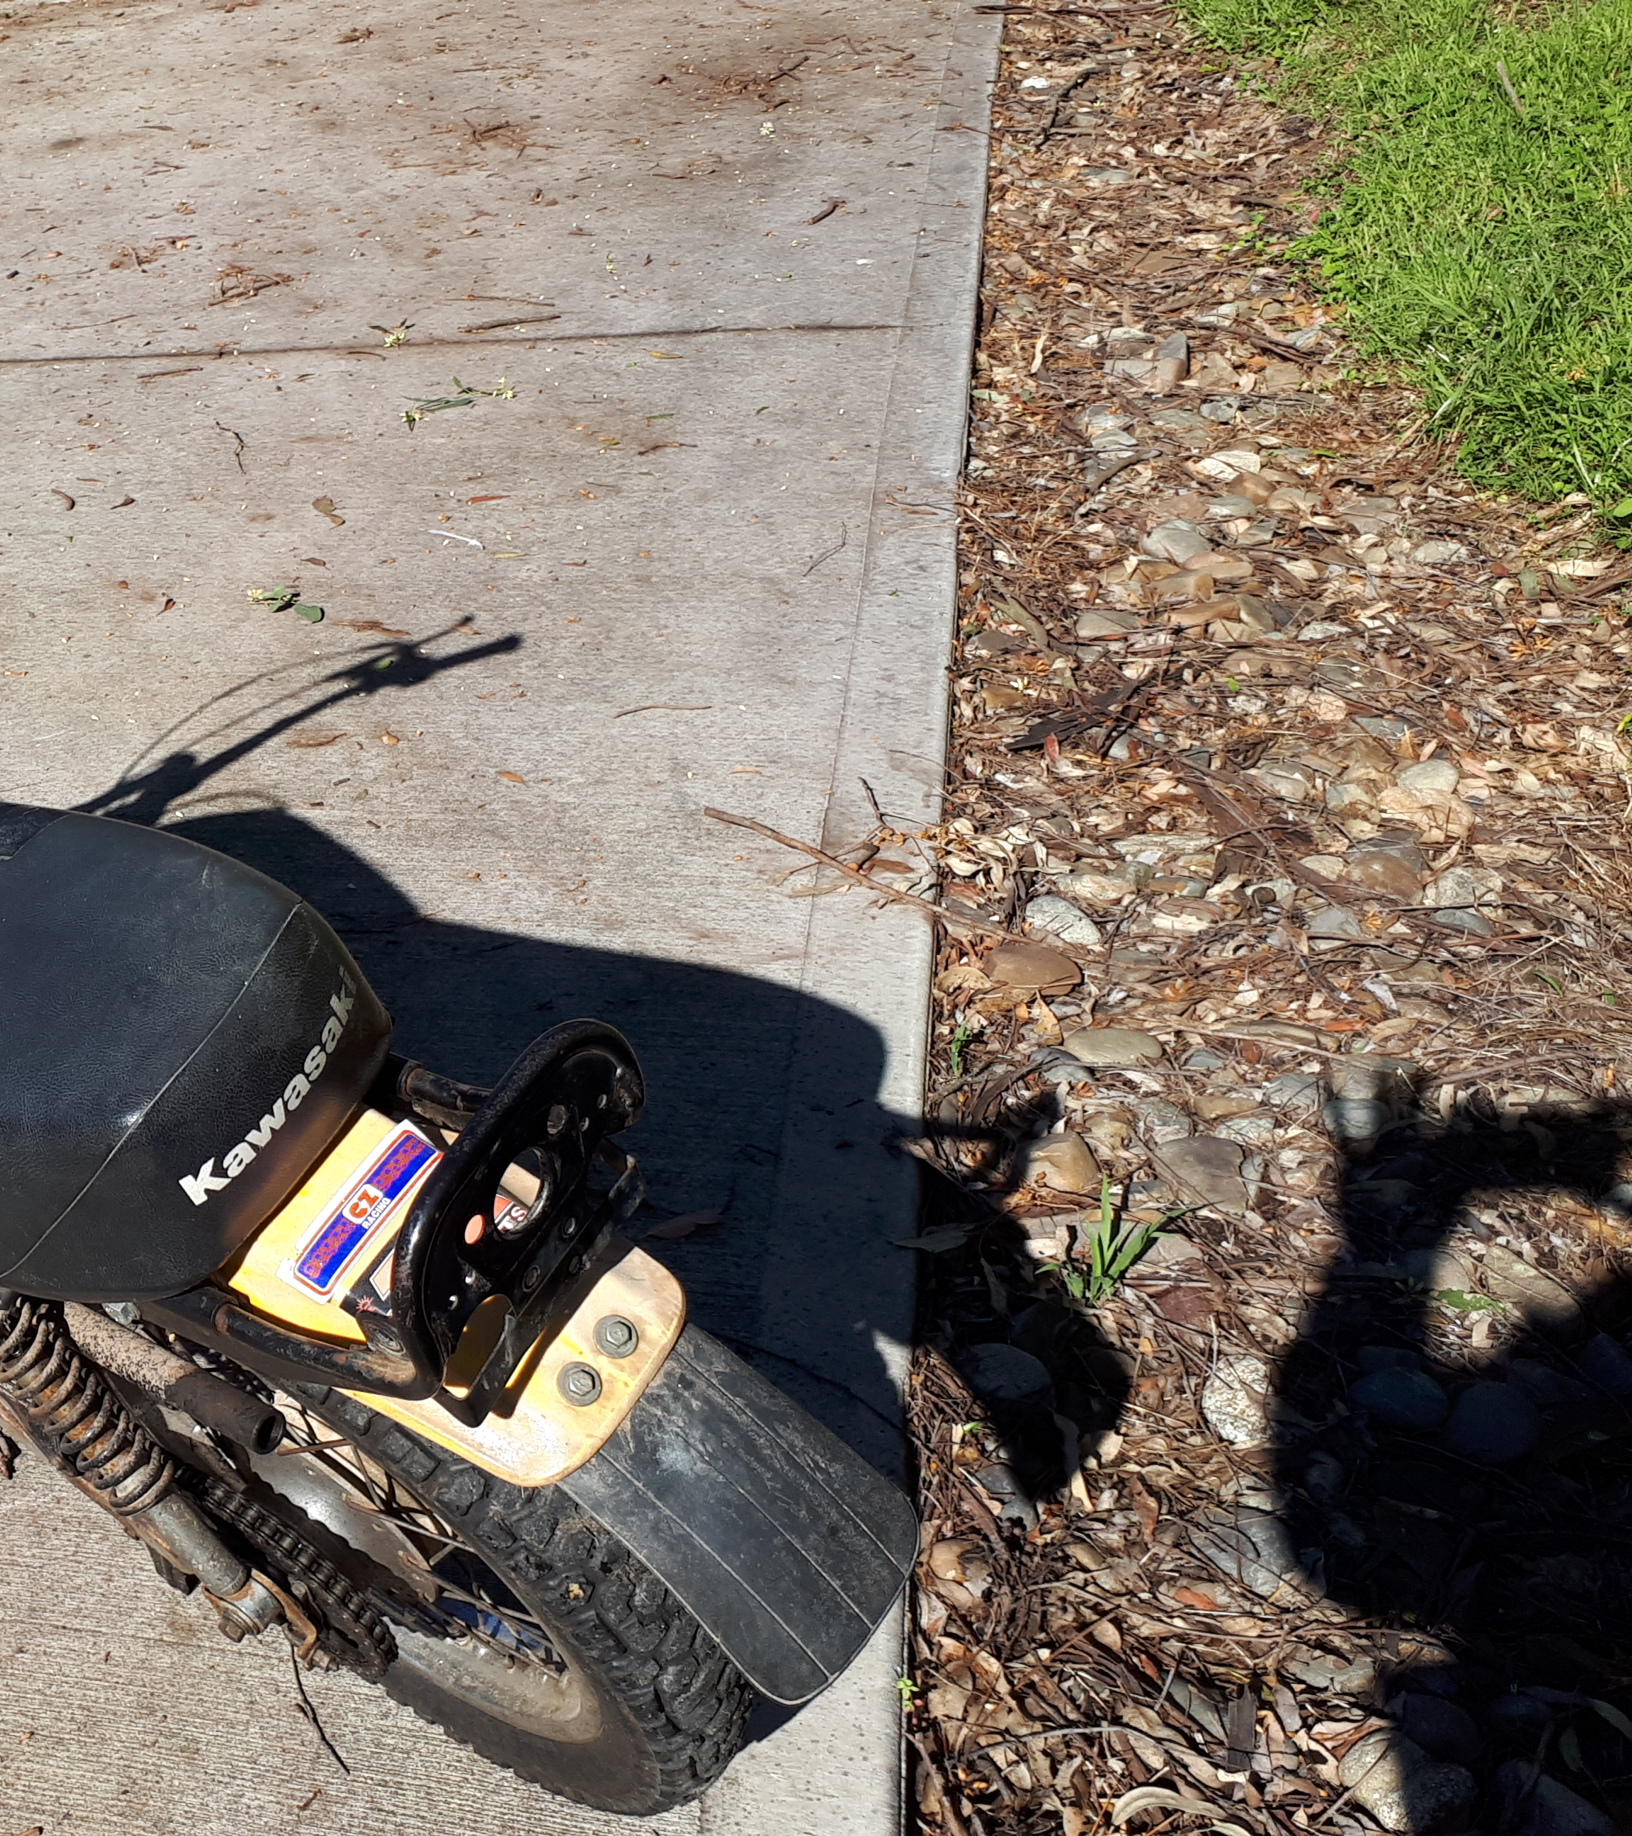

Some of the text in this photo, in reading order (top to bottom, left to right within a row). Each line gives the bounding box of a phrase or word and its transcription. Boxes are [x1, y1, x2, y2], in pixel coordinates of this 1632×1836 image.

[178, 964, 357, 1206] Kawasaki
[349, 1188, 380, 1219] CZ
[360, 1197, 392, 1229] RACING
[497, 1206, 528, 1232] TS
